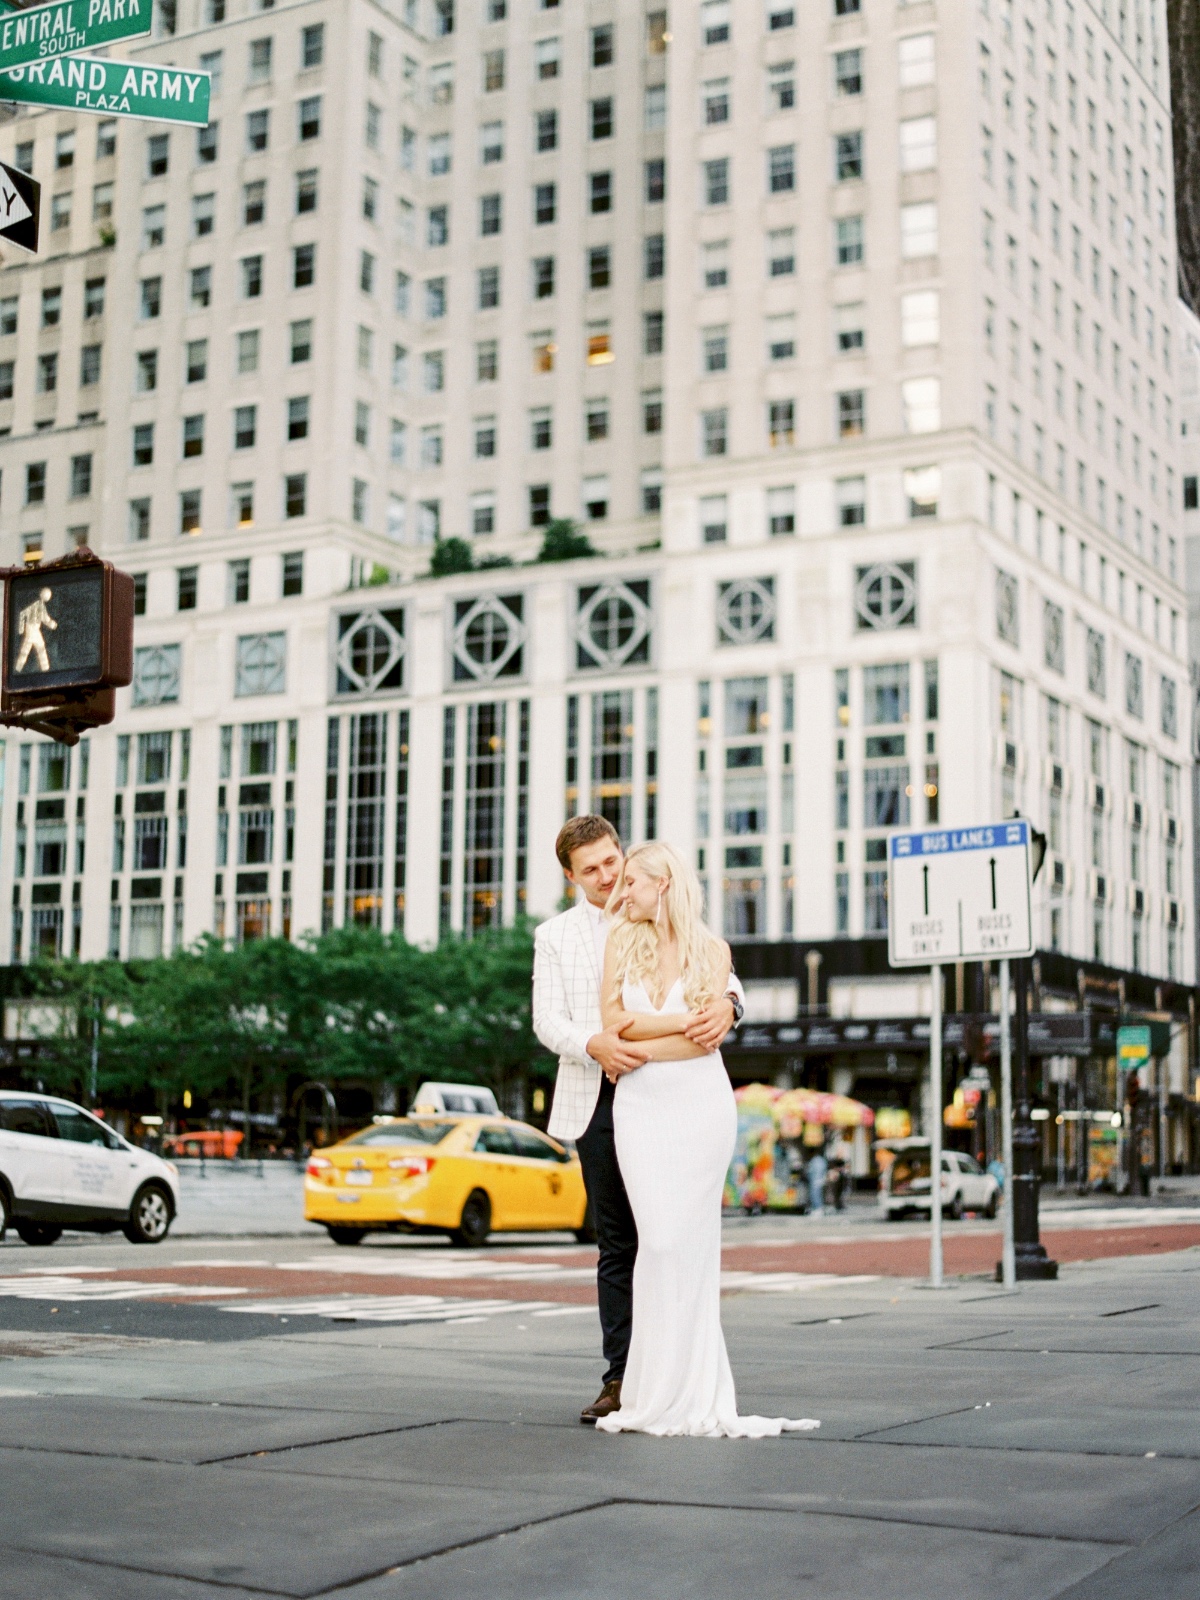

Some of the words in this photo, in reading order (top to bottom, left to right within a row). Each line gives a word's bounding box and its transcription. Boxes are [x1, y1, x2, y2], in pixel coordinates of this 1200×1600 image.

[2, 4, 76, 51] ENTRAL
[88, 0, 140, 28] PARK
[39, 30, 86, 56] SOUTH
[120, 67, 201, 104] ARMY
[75, 90, 131, 112] PLAZA
[922, 834, 949, 853] BUS
[952, 828, 995, 849] LANES
